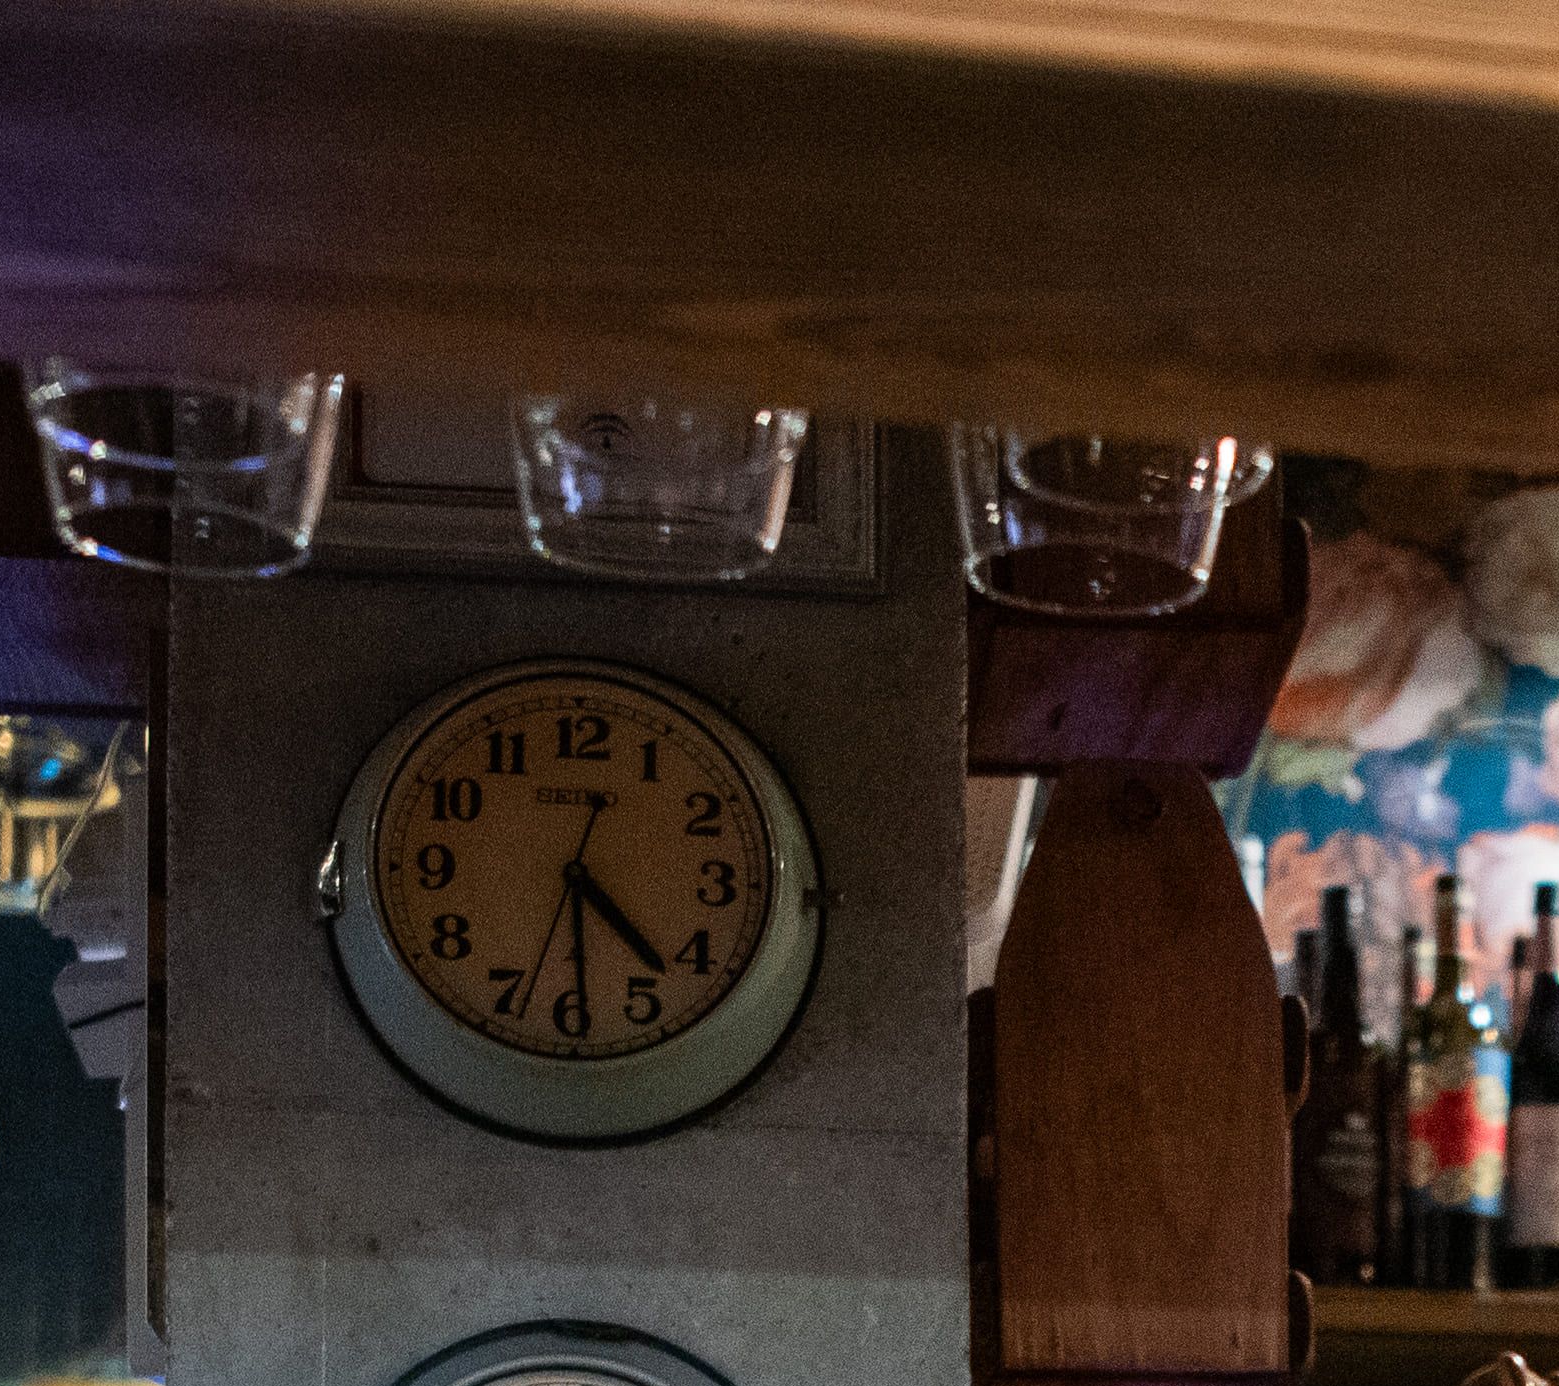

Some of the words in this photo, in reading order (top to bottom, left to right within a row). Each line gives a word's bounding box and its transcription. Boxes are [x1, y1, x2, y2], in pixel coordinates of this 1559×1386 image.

[485, 732, 526, 775] 11
[556, 716, 612, 761] 12
[641, 740, 661, 782] 1
[428, 778, 482, 822] 10
[685, 792, 721, 837] 2
[417, 844, 456, 890] 9
[697, 861, 737, 907] 3
[430, 915, 473, 961] 8
[674, 930, 716, 975] 4
[488, 970, 526, 1015] 7
[552, 990, 591, 1039] 6
[624, 977, 662, 1025] 5
